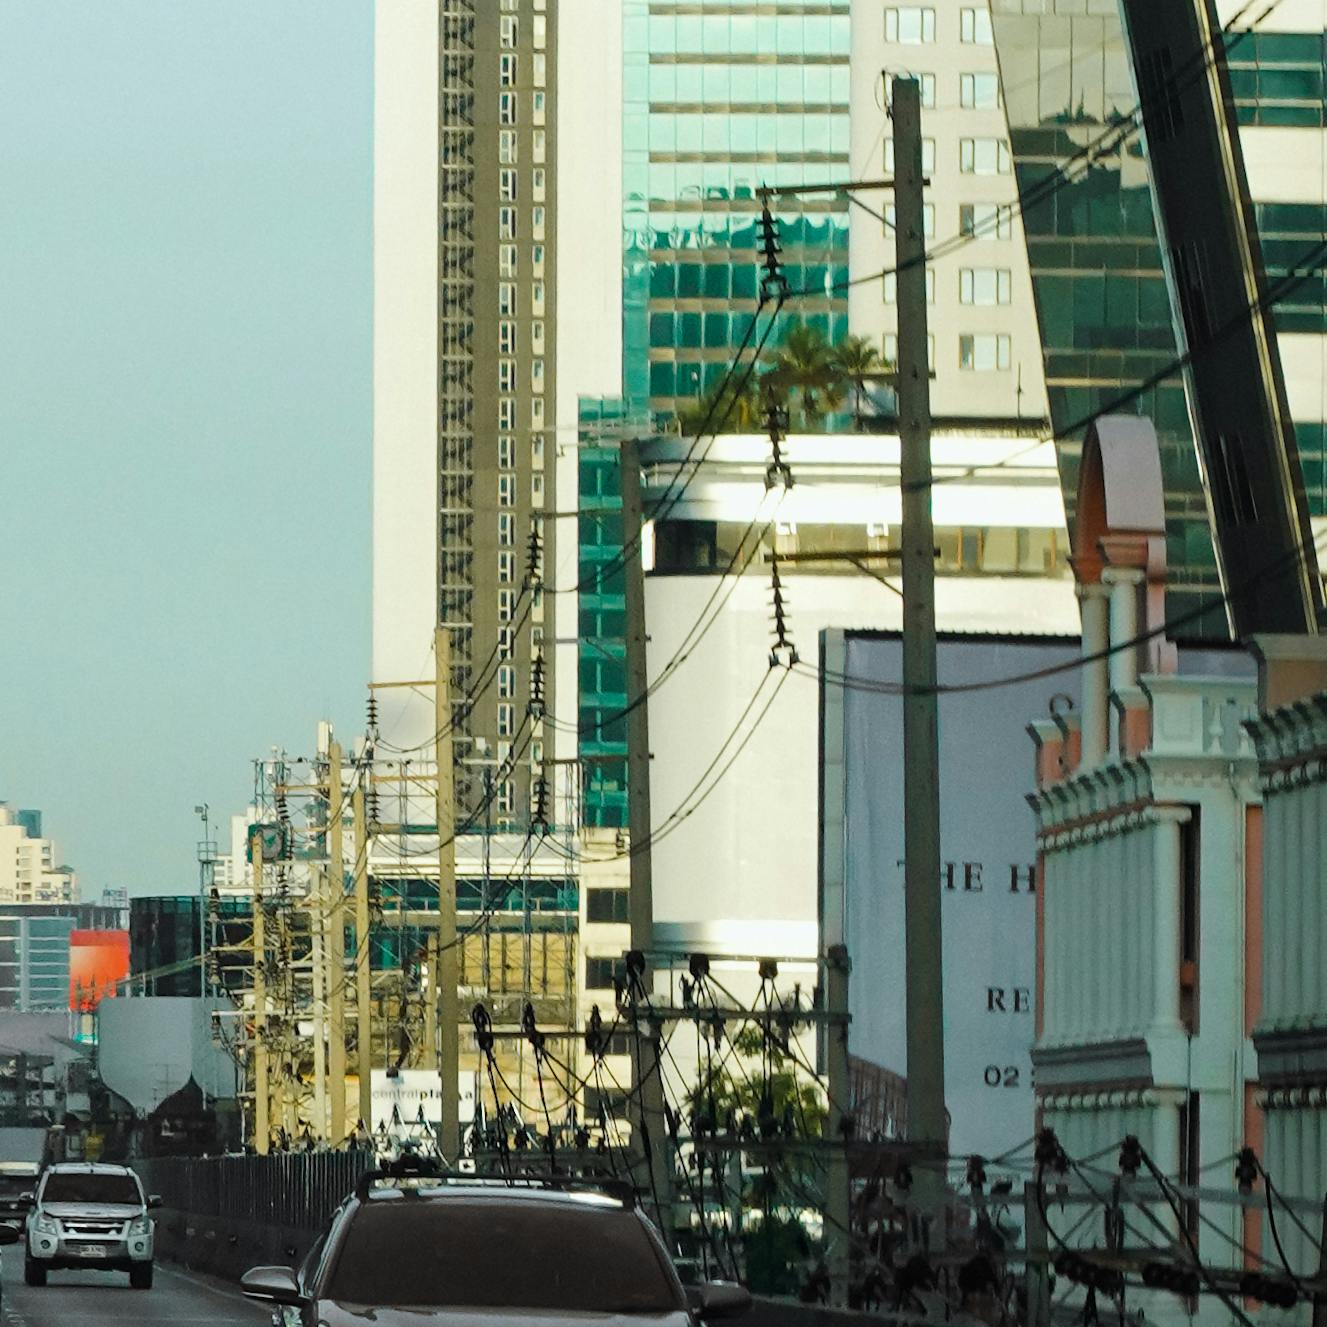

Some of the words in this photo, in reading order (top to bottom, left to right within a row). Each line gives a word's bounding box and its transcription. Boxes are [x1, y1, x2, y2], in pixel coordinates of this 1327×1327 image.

[896, 861, 983, 892] HE
[984, 1064, 1020, 1088] 02
[372, 1087, 473, 1101] centralplaa
